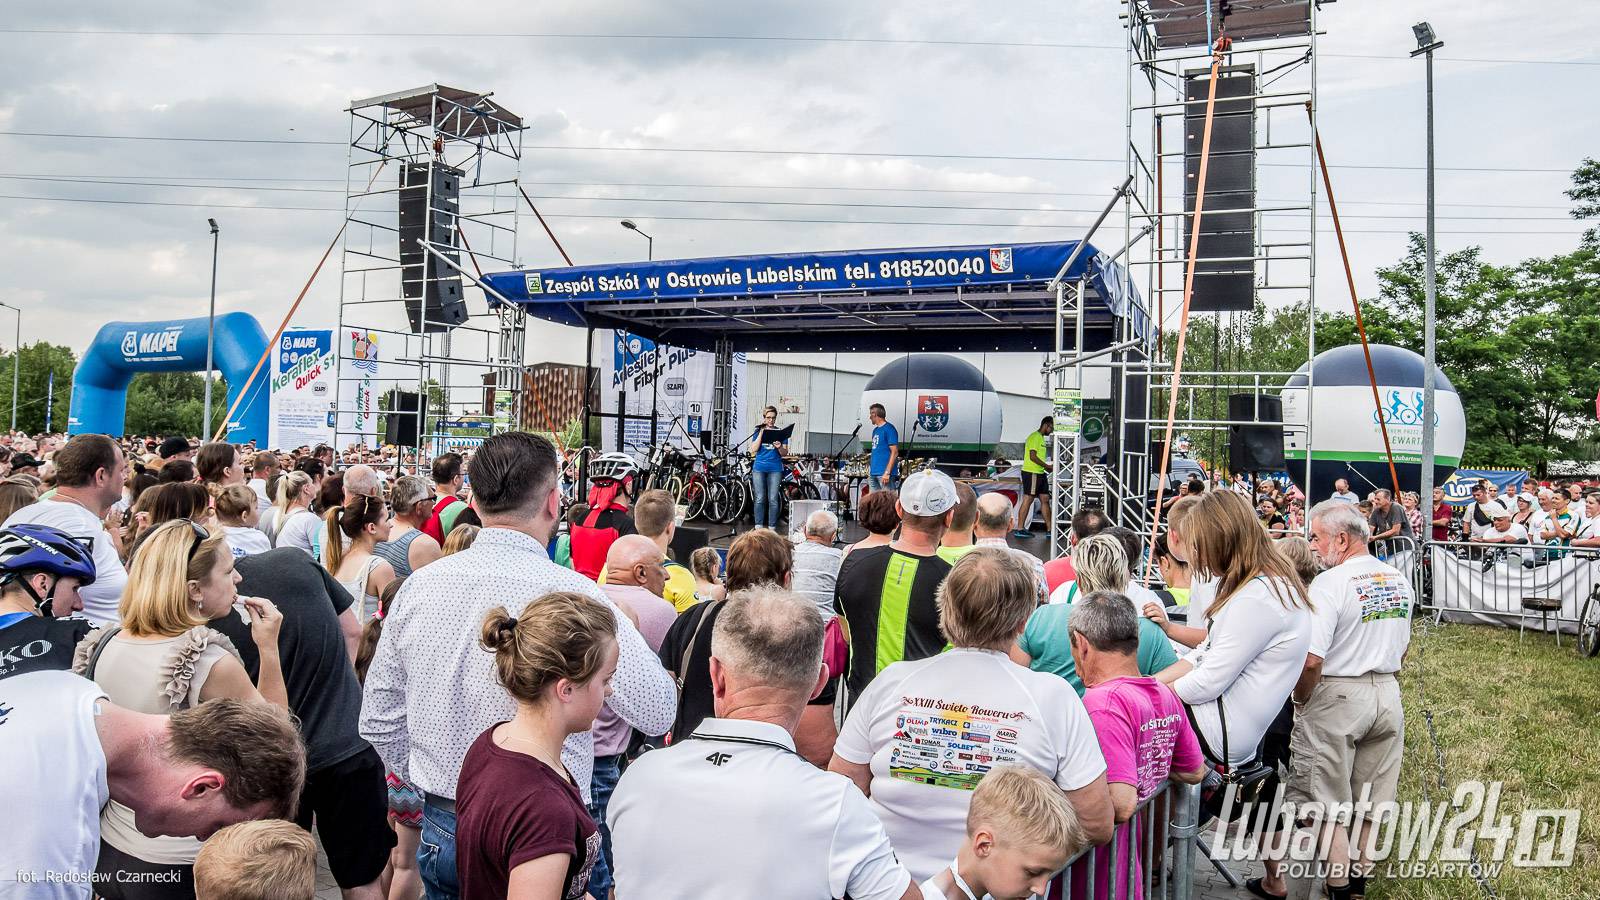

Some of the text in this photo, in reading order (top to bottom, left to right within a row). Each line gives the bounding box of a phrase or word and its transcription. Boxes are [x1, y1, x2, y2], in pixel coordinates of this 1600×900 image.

[544, 257, 985, 296] Zespół Szkół w Ostrowie Lubelskim tel. 818520040
[139, 330, 183, 353] MAPEI
[293, 337, 317, 348] MAPEI
[668, 348, 697, 370] Plus
[272, 348, 320, 393] Keraflex
[295, 365, 321, 390] Quick
[690, 403, 701, 413] 10
[913, 697, 1010, 719] XXIII Święto Roweru
[930, 716, 958, 727] TRYKACZ
[947, 742, 975, 751] SOLBET
[705, 752, 732, 766] 4F
